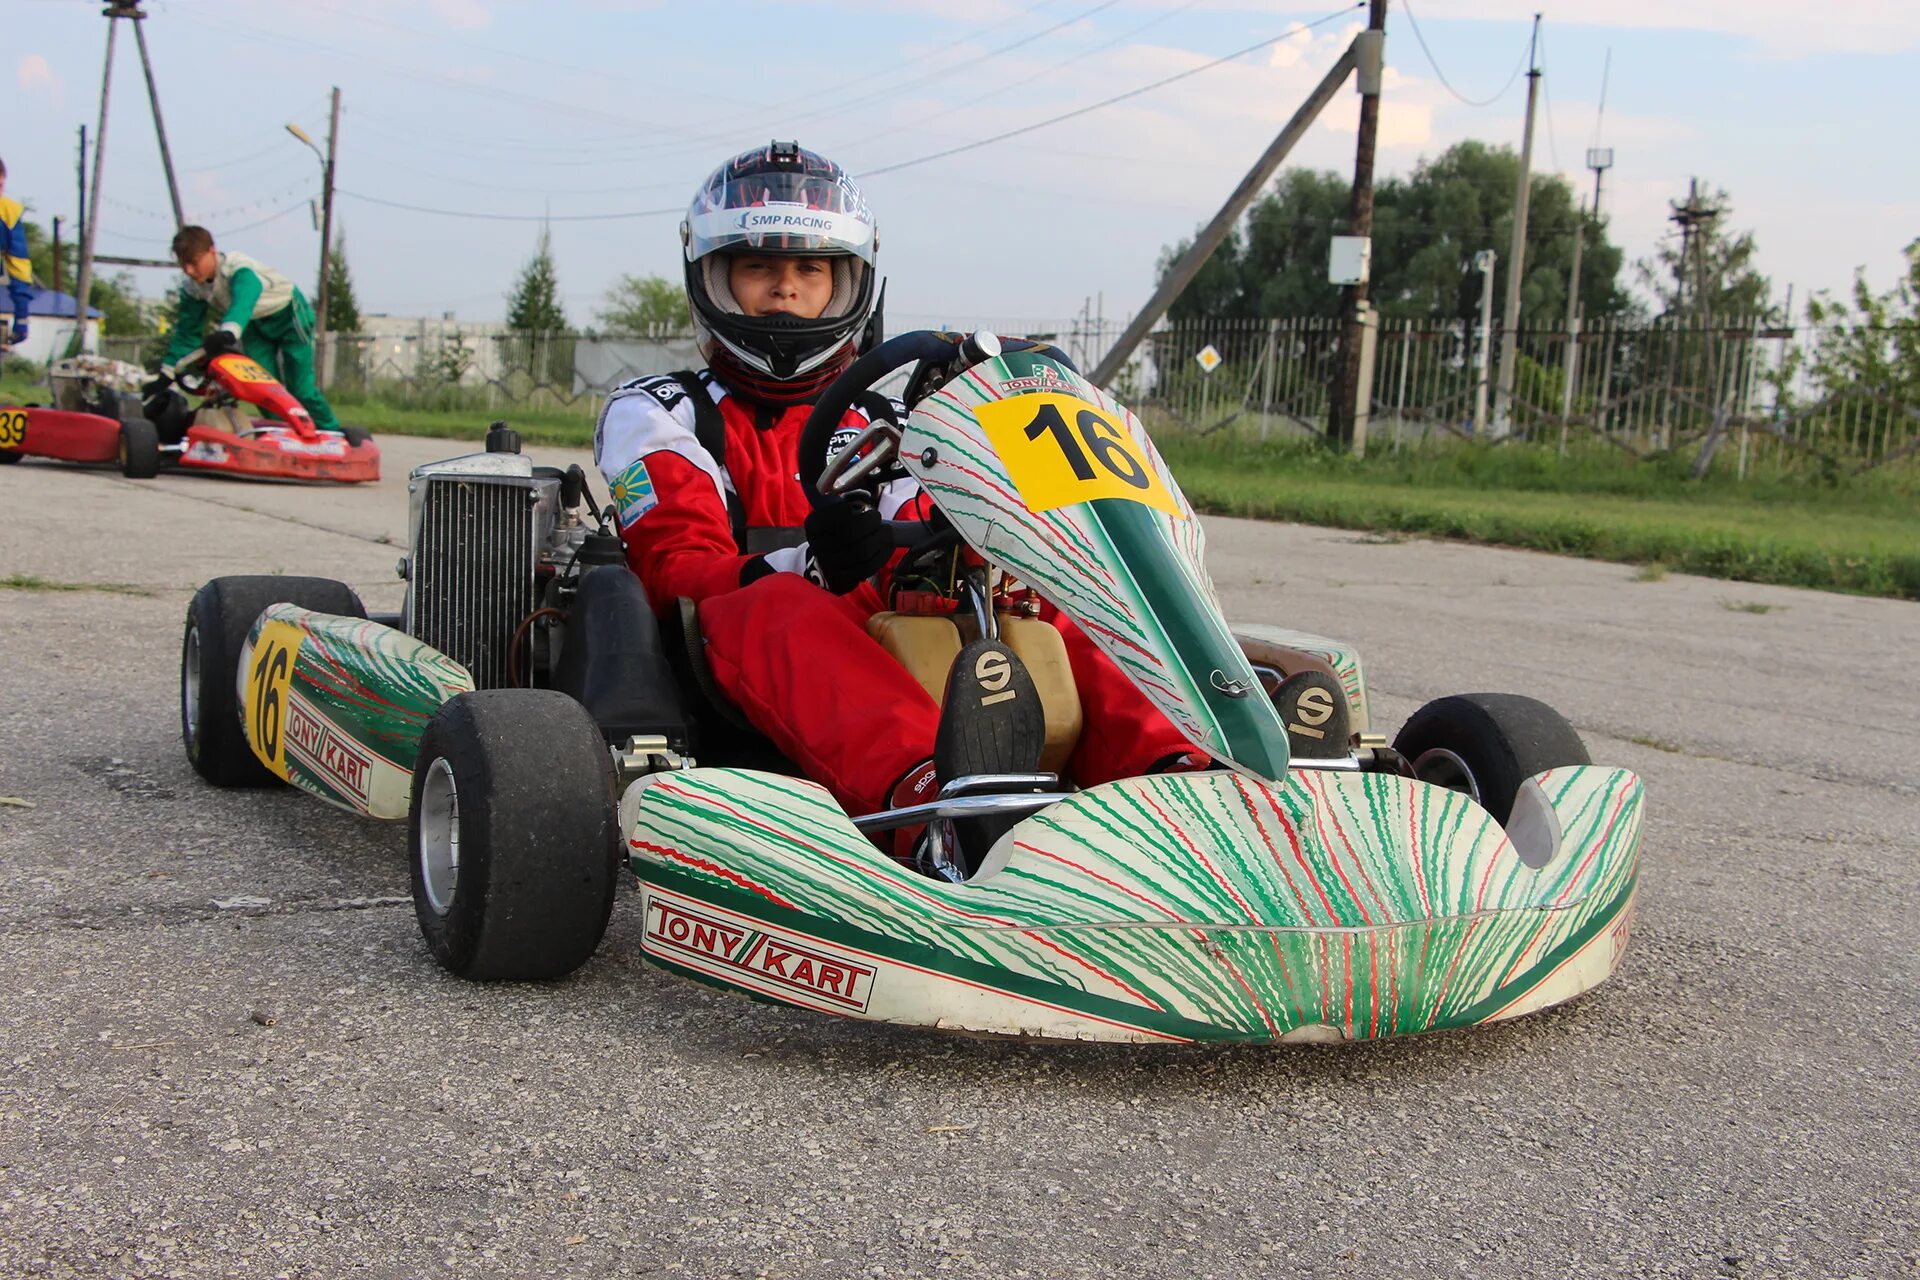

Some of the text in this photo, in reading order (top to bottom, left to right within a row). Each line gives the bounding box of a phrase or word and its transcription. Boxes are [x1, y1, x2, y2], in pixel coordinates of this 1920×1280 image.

[751, 215, 833, 230] SMP RACING
[0, 412, 27, 444] 39
[1023, 403, 1150, 490] 16
[254, 640, 288, 763] 16
[289, 701, 321, 755] TONY
[325, 733, 371, 791] KART
[914, 769, 936, 793] spar
[651, 901, 873, 998] TONY KART
